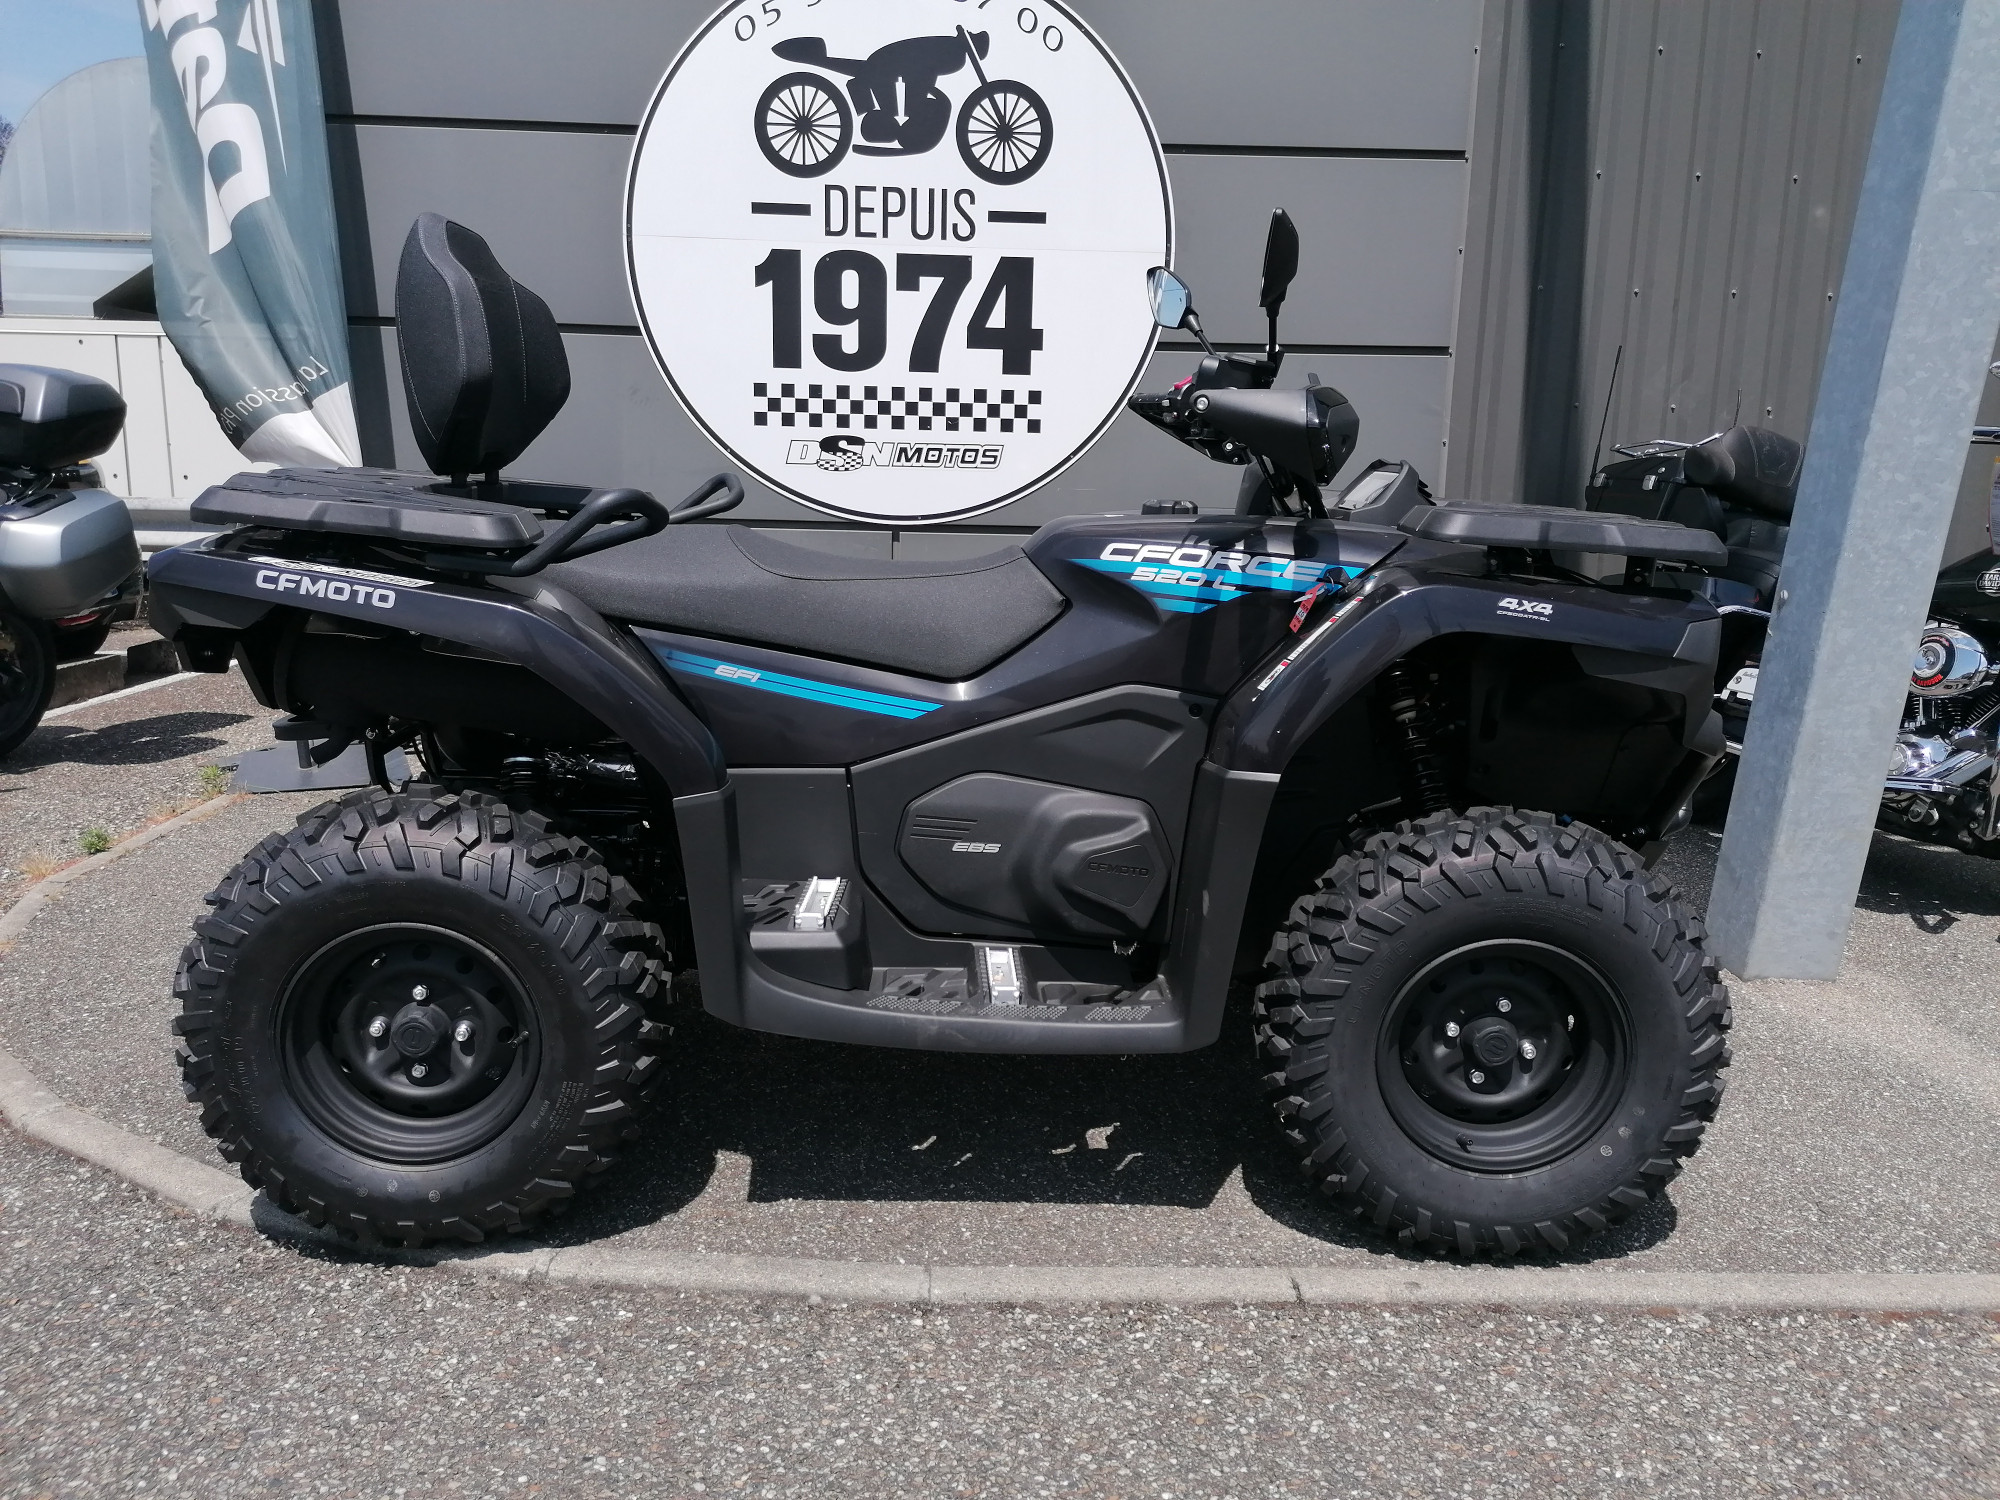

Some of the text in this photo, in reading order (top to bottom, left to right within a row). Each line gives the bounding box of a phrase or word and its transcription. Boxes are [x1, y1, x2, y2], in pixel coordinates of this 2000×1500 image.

[1016, 7, 1064, 52] 00
[824, 184, 976, 242] DEPUIS
[754, 248, 1044, 375] 1974
[786, 434, 1005, 472] DSN MOTOS
[1099, 542, 1326, 582] CFORCE
[1130, 566, 1238, 592] 520 L
[255, 568, 397, 610] CFMOTO
[714, 664, 762, 684] EFI
[951, 841, 1002, 854] EBS
[1087, 861, 1149, 879] CFMOTO
